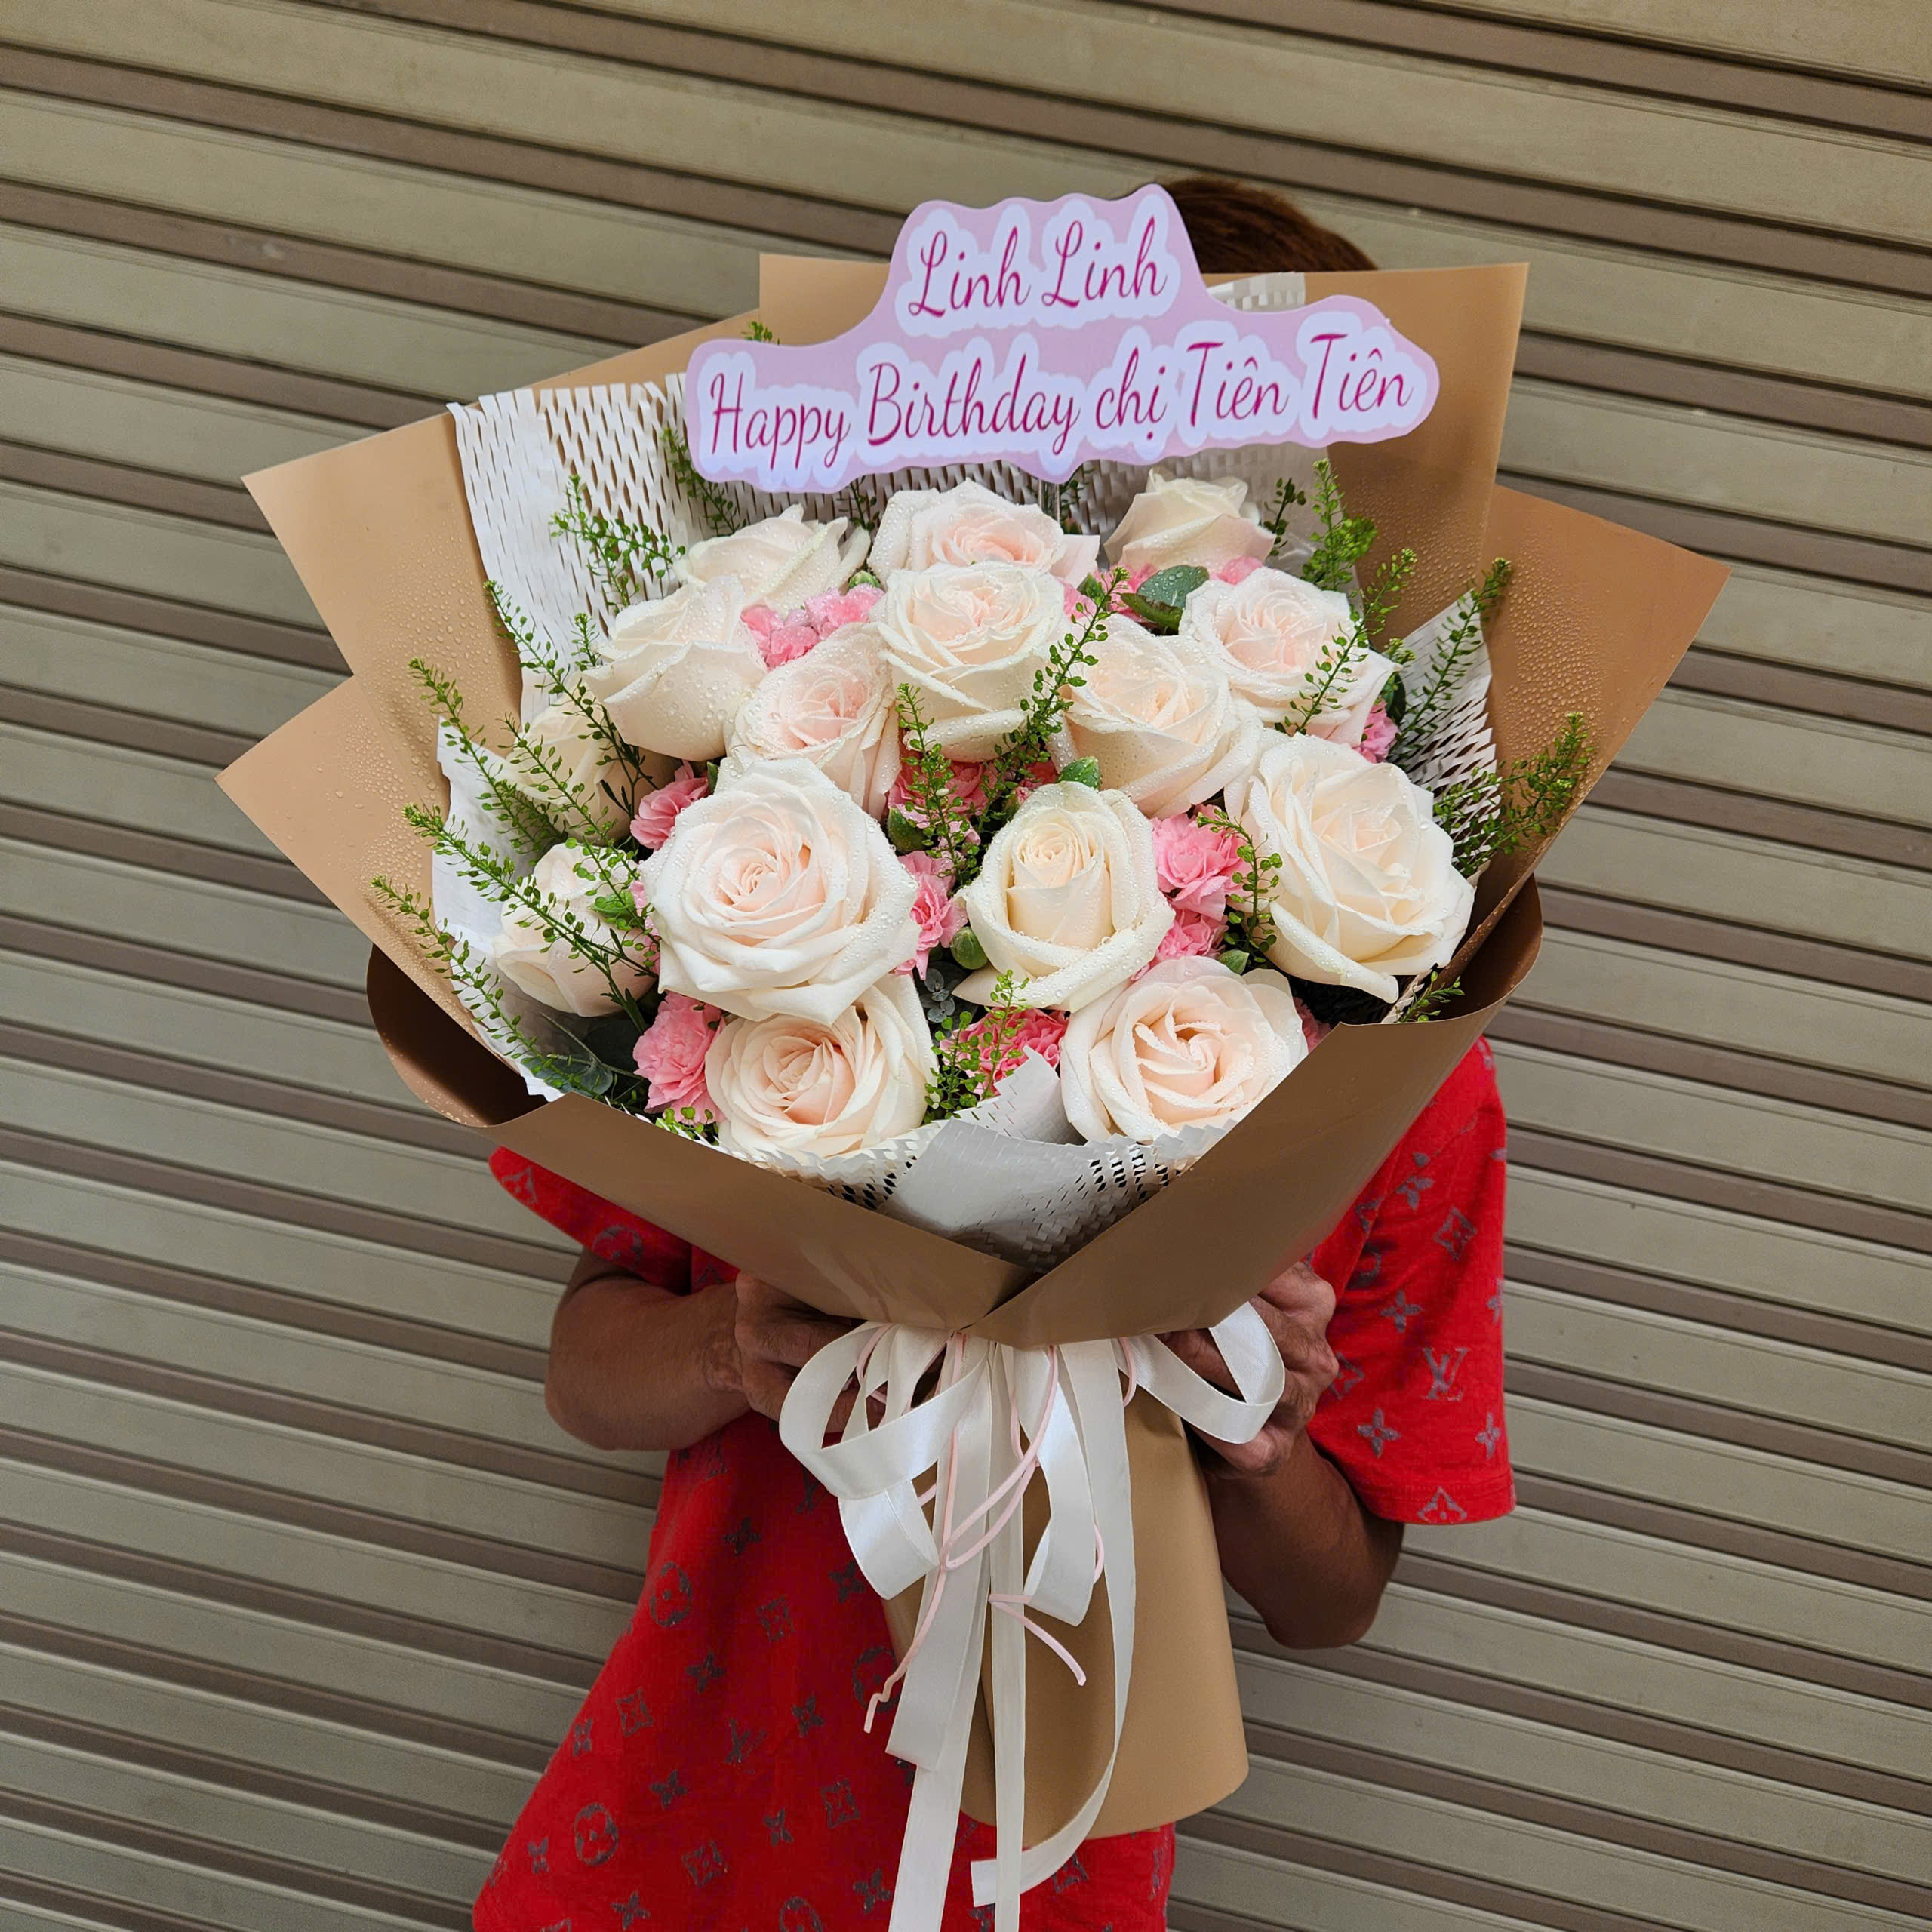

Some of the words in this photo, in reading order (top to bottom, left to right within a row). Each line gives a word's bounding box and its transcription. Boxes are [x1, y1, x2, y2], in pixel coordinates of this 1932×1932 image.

[907, 226, 1031, 318] Linh
[1041, 217, 1167, 308] Linh
[709, 371, 851, 469] Happy
[868, 352, 1081, 455] Birthday
[1094, 346, 1167, 440] chị
[1186, 340, 1290, 427] Tiên
[1309, 332, 1414, 418] Tiên
